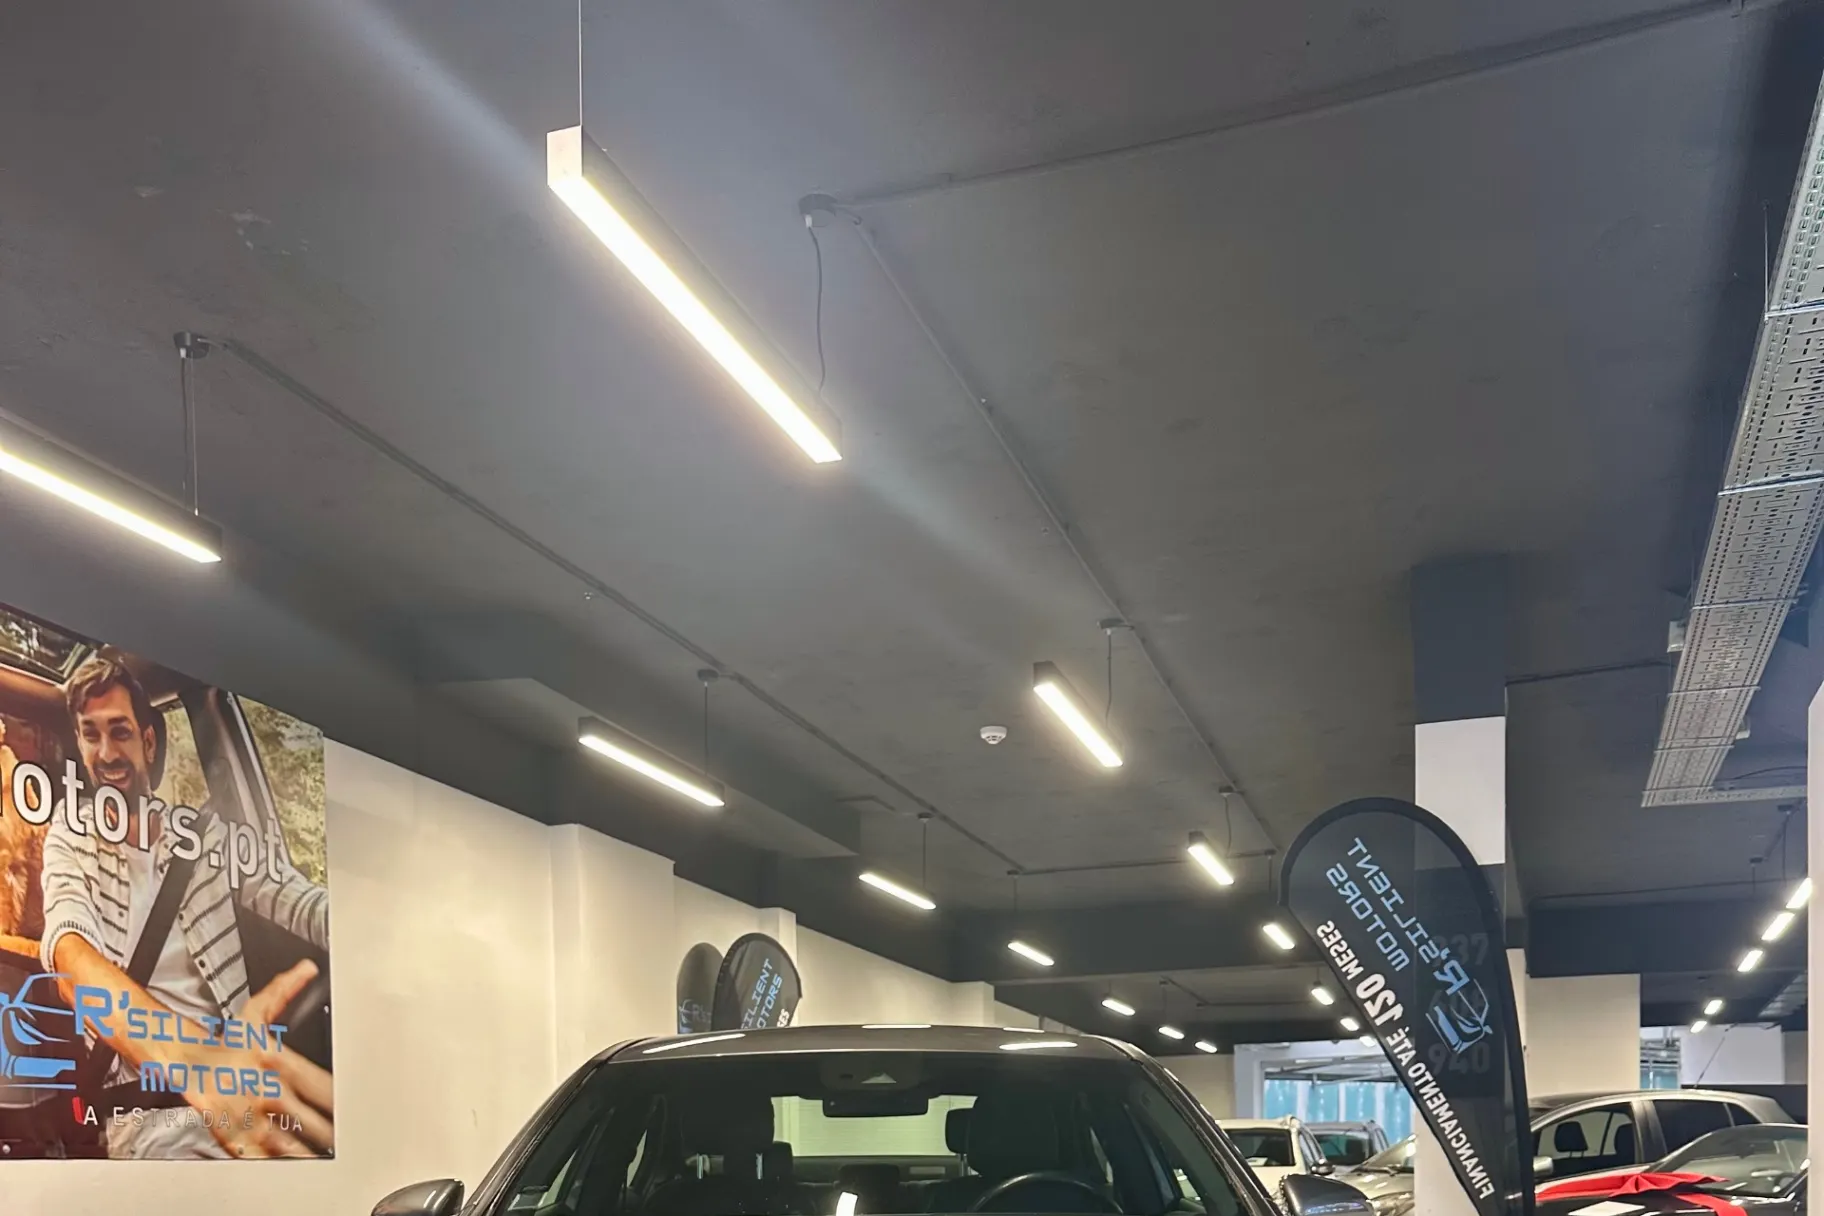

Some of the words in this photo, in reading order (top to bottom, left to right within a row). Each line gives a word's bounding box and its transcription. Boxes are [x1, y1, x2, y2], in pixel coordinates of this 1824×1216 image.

[0, 759, 281, 889] otors.pt
[75, 984, 288, 1053] R'SILIENT
[140, 1060, 281, 1099] MOTORS
[83, 1105, 98, 1126] A
[113, 1106, 230, 1129] ESTRADA
[243, 1106, 254, 1129] É
[267, 1112, 303, 1132] TUA
